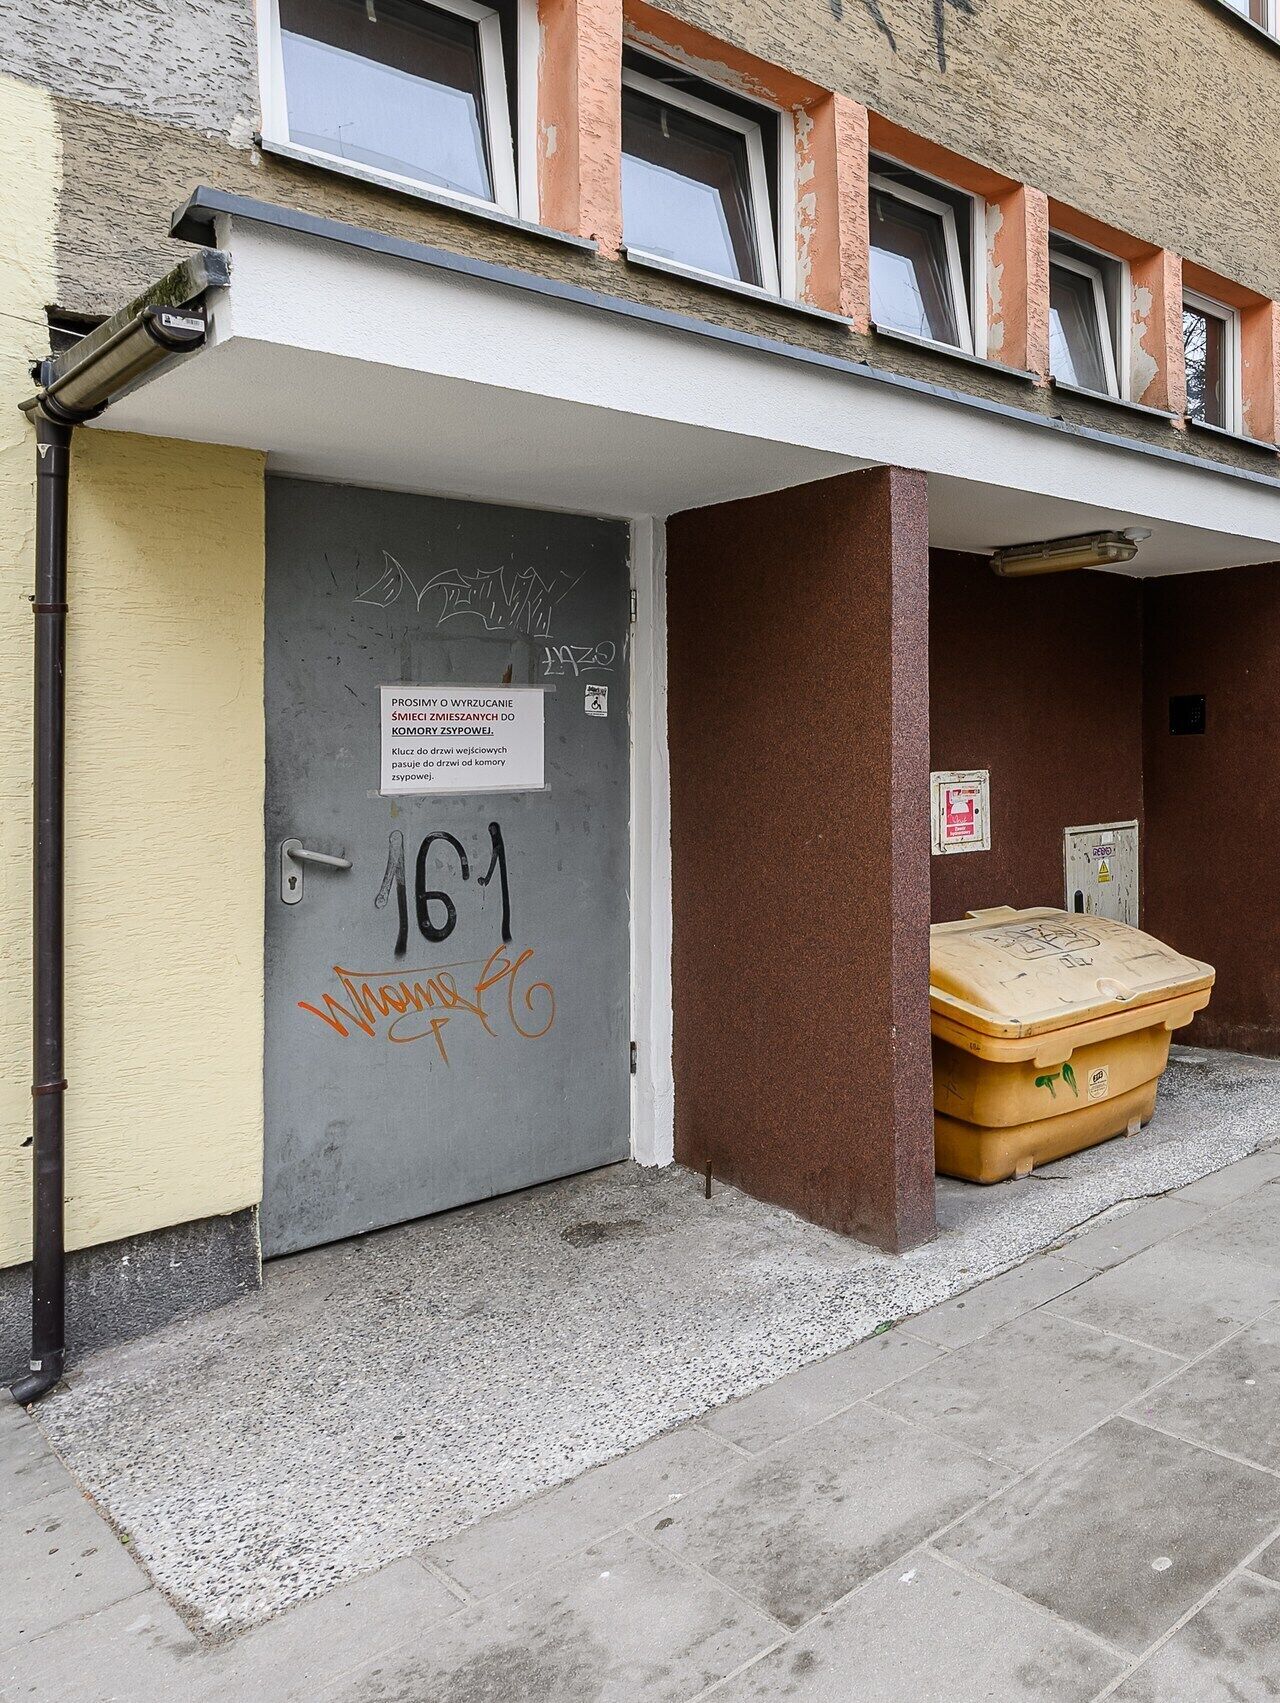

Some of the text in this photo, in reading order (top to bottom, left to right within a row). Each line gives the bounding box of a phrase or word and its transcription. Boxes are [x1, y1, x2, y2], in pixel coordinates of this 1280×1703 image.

[391, 698, 513, 708] PROSIMY O WYRZUCANIE
[391, 711, 515, 721] ŚMIECI ZMIESZANYCH DO
[392, 727, 494, 736] KOMORY ZSYPOWEJ.
[392, 746, 507, 757] Klucz do drzwi wejściowych
[391, 758, 506, 769] pasuje do drzwi od komory
[391, 772, 435, 782] zsypowej.
[374, 822, 512, 958] 161
